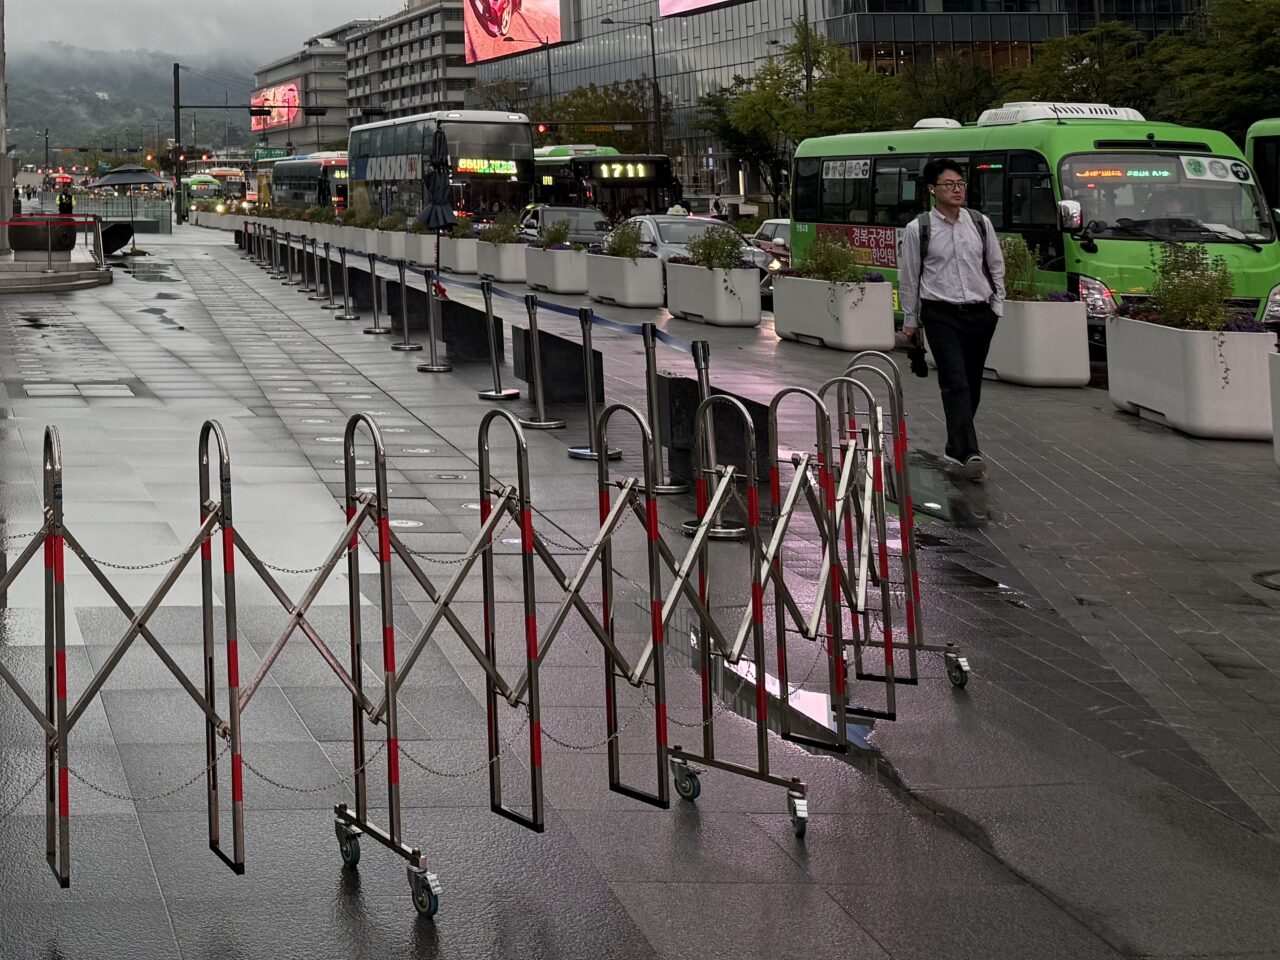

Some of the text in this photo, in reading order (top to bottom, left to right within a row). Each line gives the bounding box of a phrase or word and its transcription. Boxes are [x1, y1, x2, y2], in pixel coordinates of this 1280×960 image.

[600, 163, 645, 179] 1711
[852, 227, 894, 246] 경복궁경희
[872, 247, 896, 266] 한의원
